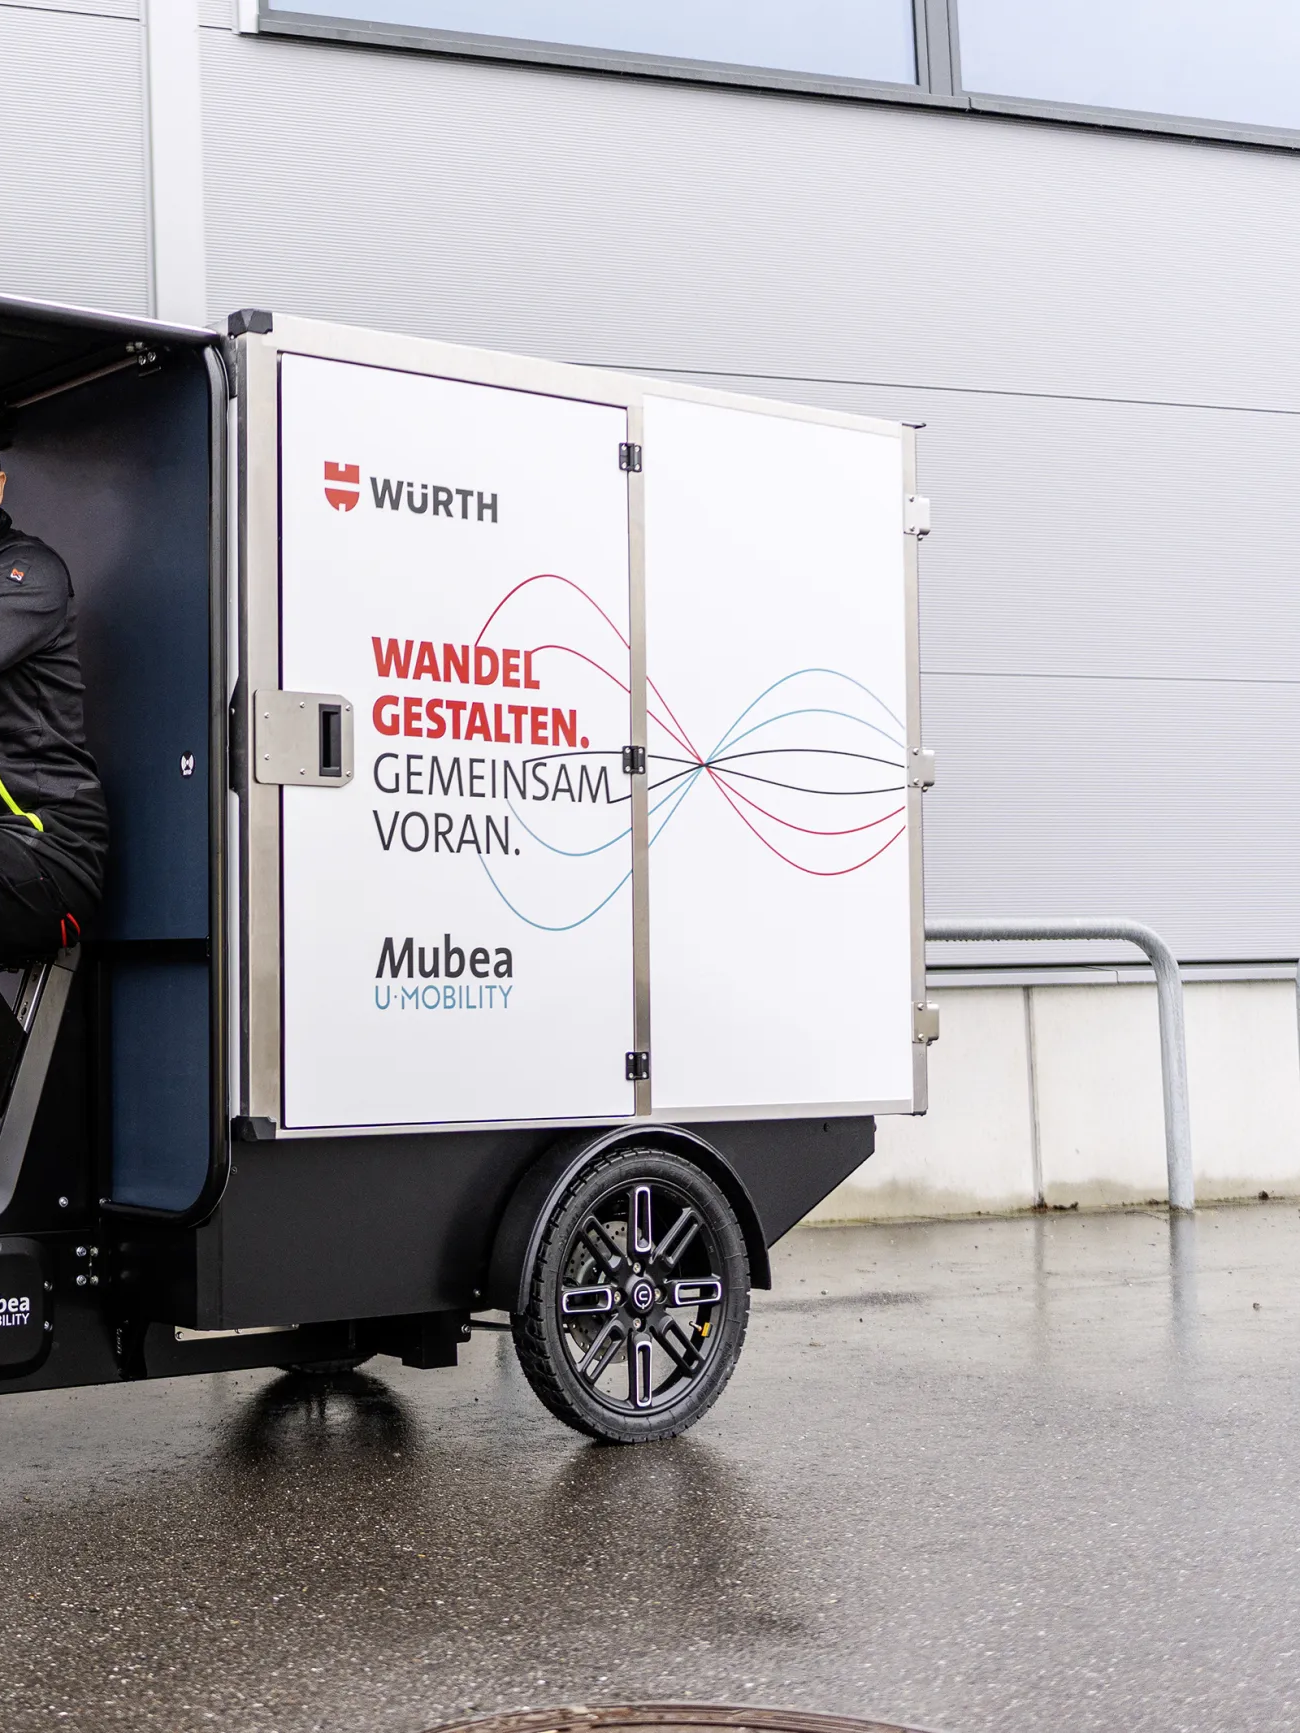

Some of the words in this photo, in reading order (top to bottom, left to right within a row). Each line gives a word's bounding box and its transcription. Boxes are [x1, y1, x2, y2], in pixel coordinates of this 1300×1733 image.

[369, 476, 498, 523] WÜRTH
[371, 636, 540, 690] WANDEL
[372, 695, 589, 749] GESTALTEN.
[374, 752, 611, 804] GEMEINSAM
[373, 810, 520, 856] VORAN.
[375, 933, 513, 979] Mubea
